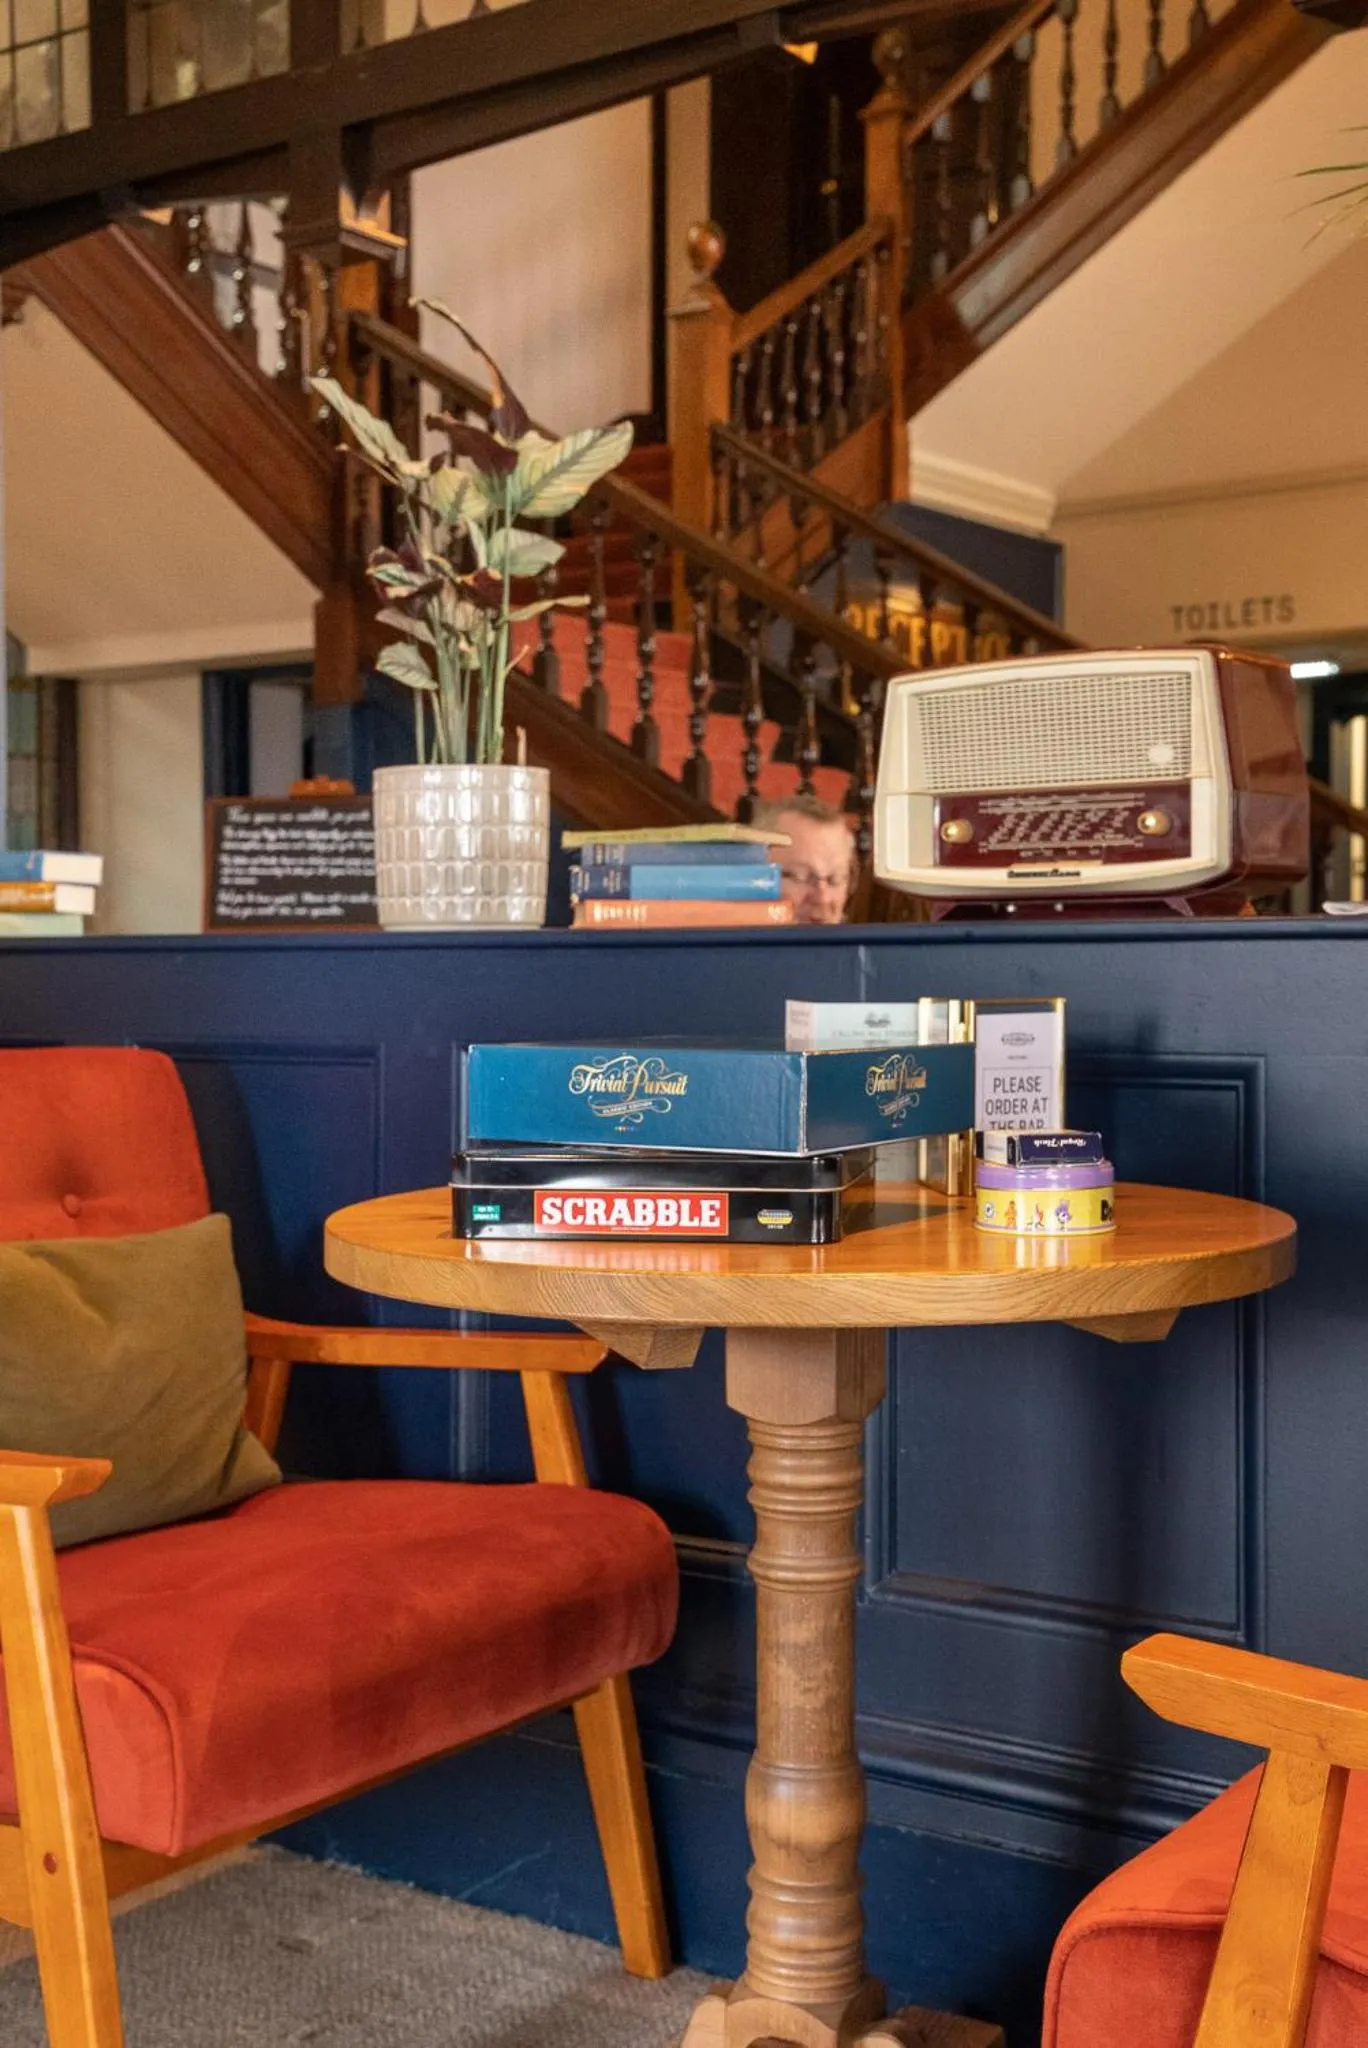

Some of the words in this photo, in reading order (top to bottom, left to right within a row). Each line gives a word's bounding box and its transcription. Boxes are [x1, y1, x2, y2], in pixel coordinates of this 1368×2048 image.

[1171, 593, 1297, 632] TOILETS
[569, 1055, 637, 1095] Trivial
[626, 1057, 689, 1101] Pursuit
[993, 1075, 1043, 1094] PLEASE
[985, 1098, 1028, 1116] ORDER
[1031, 1097, 1048, 1113] AT
[541, 1196, 721, 1228] SCRABBLE
